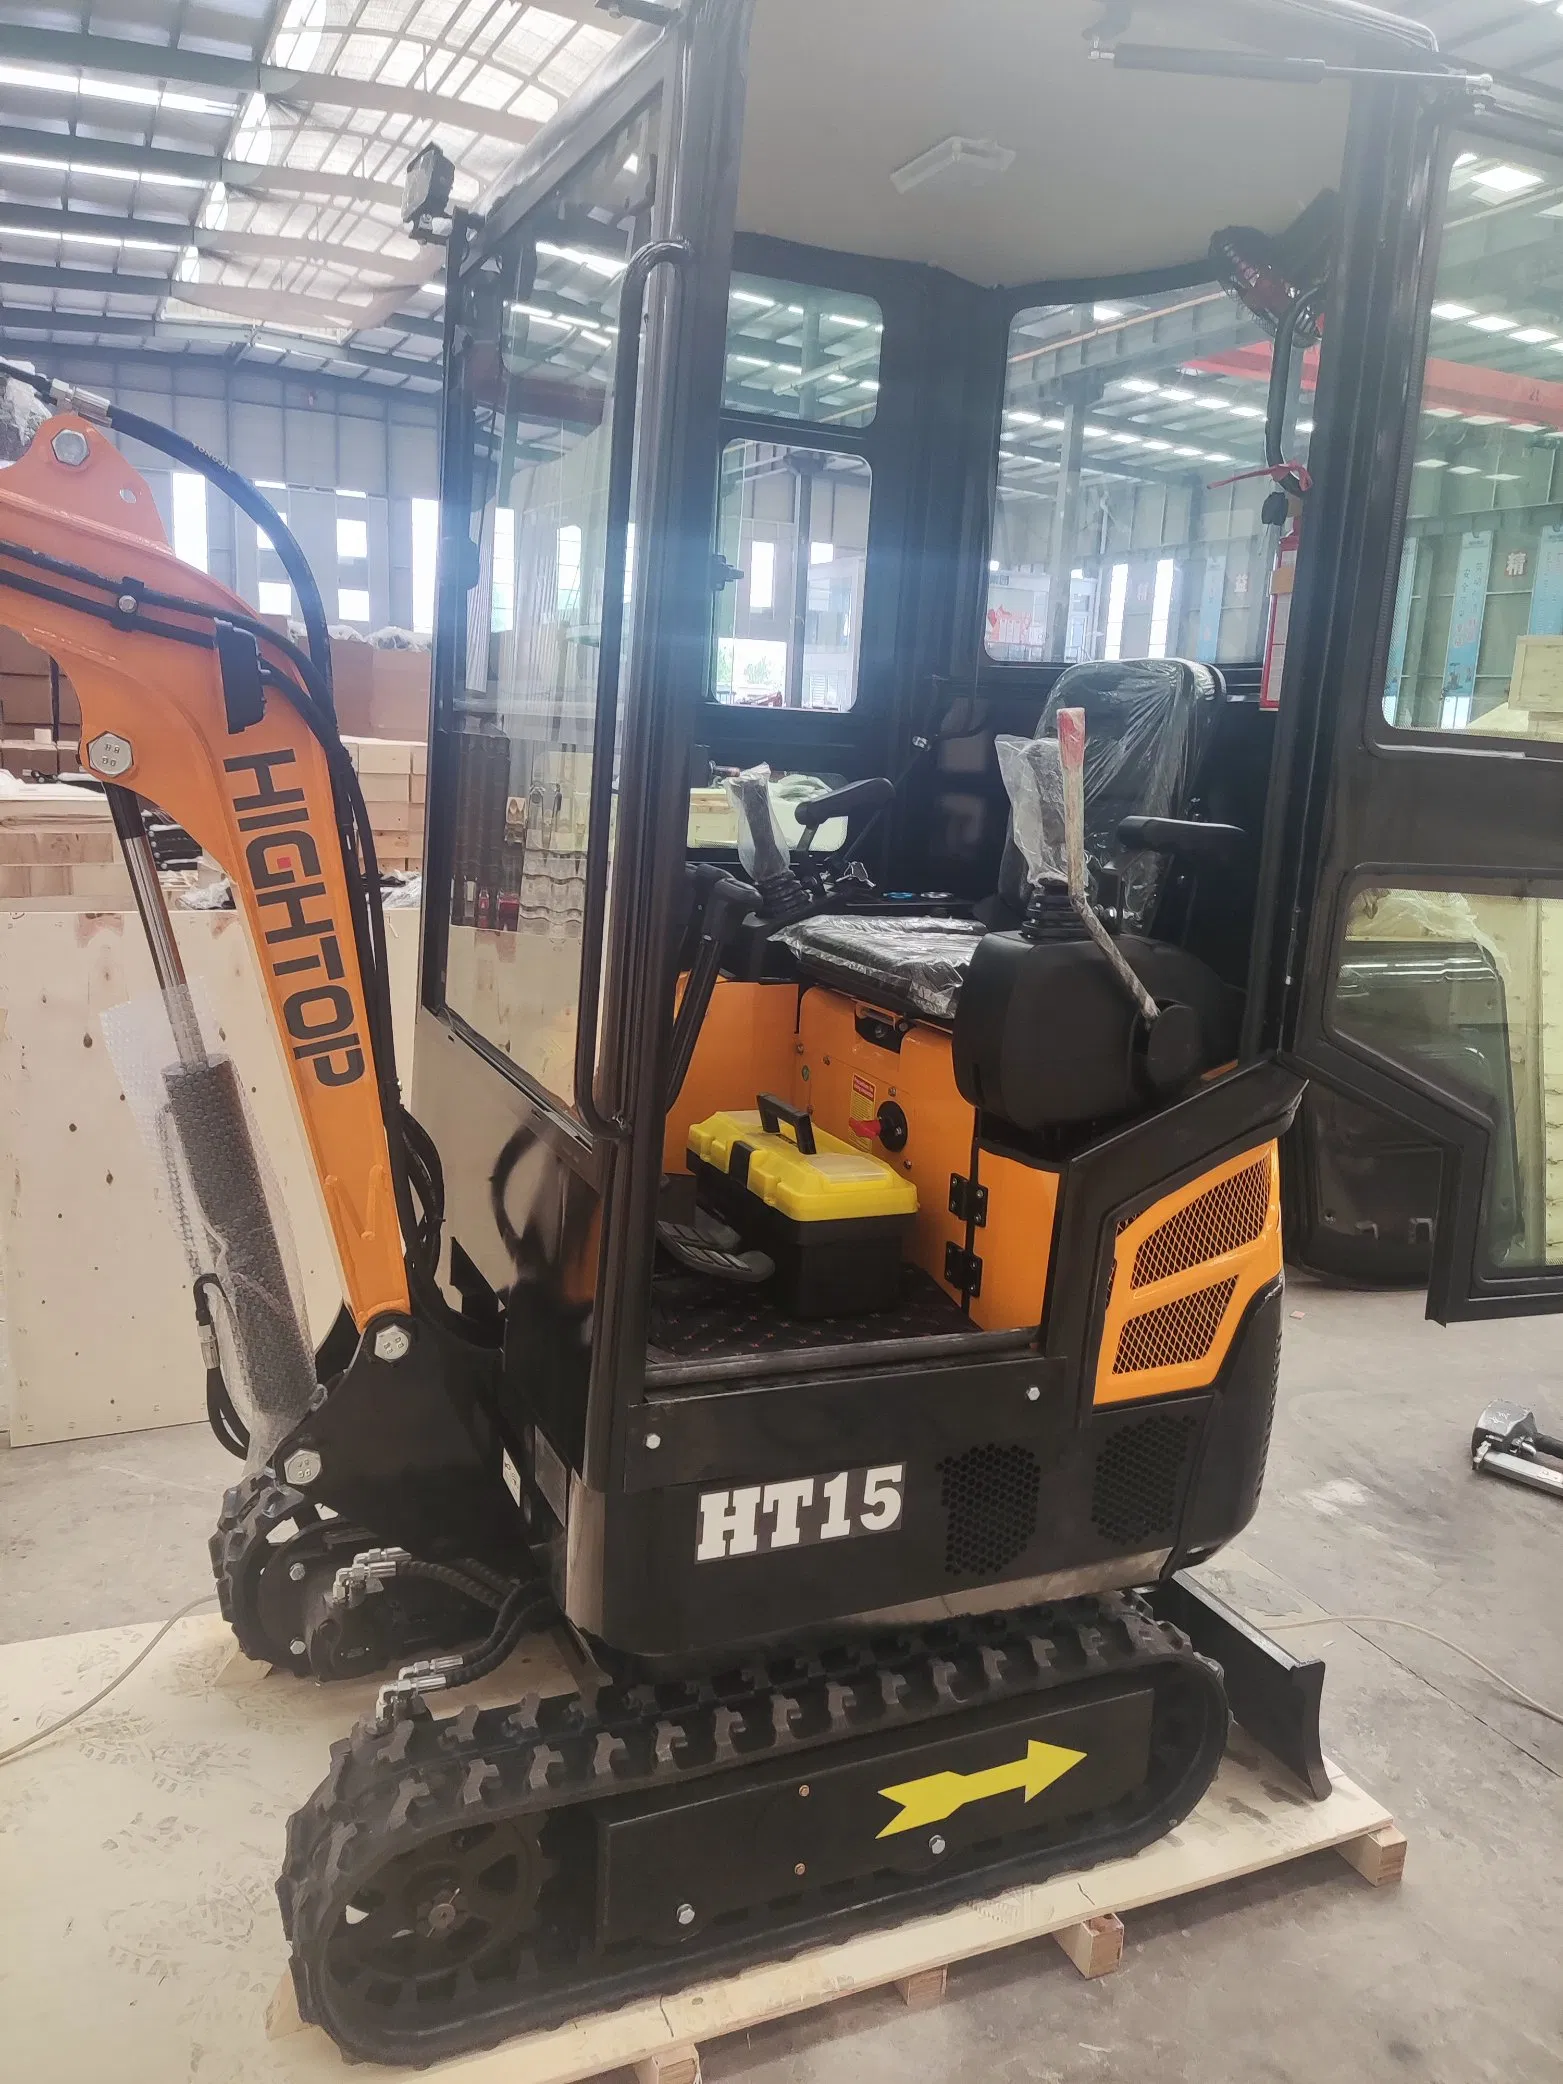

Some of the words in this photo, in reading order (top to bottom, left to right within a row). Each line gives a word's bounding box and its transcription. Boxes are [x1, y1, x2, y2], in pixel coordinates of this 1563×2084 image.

[1506, 551, 1527, 576] 精
[223, 749, 366, 1087] HIGHTOP
[697, 1464, 903, 1561] HT15
